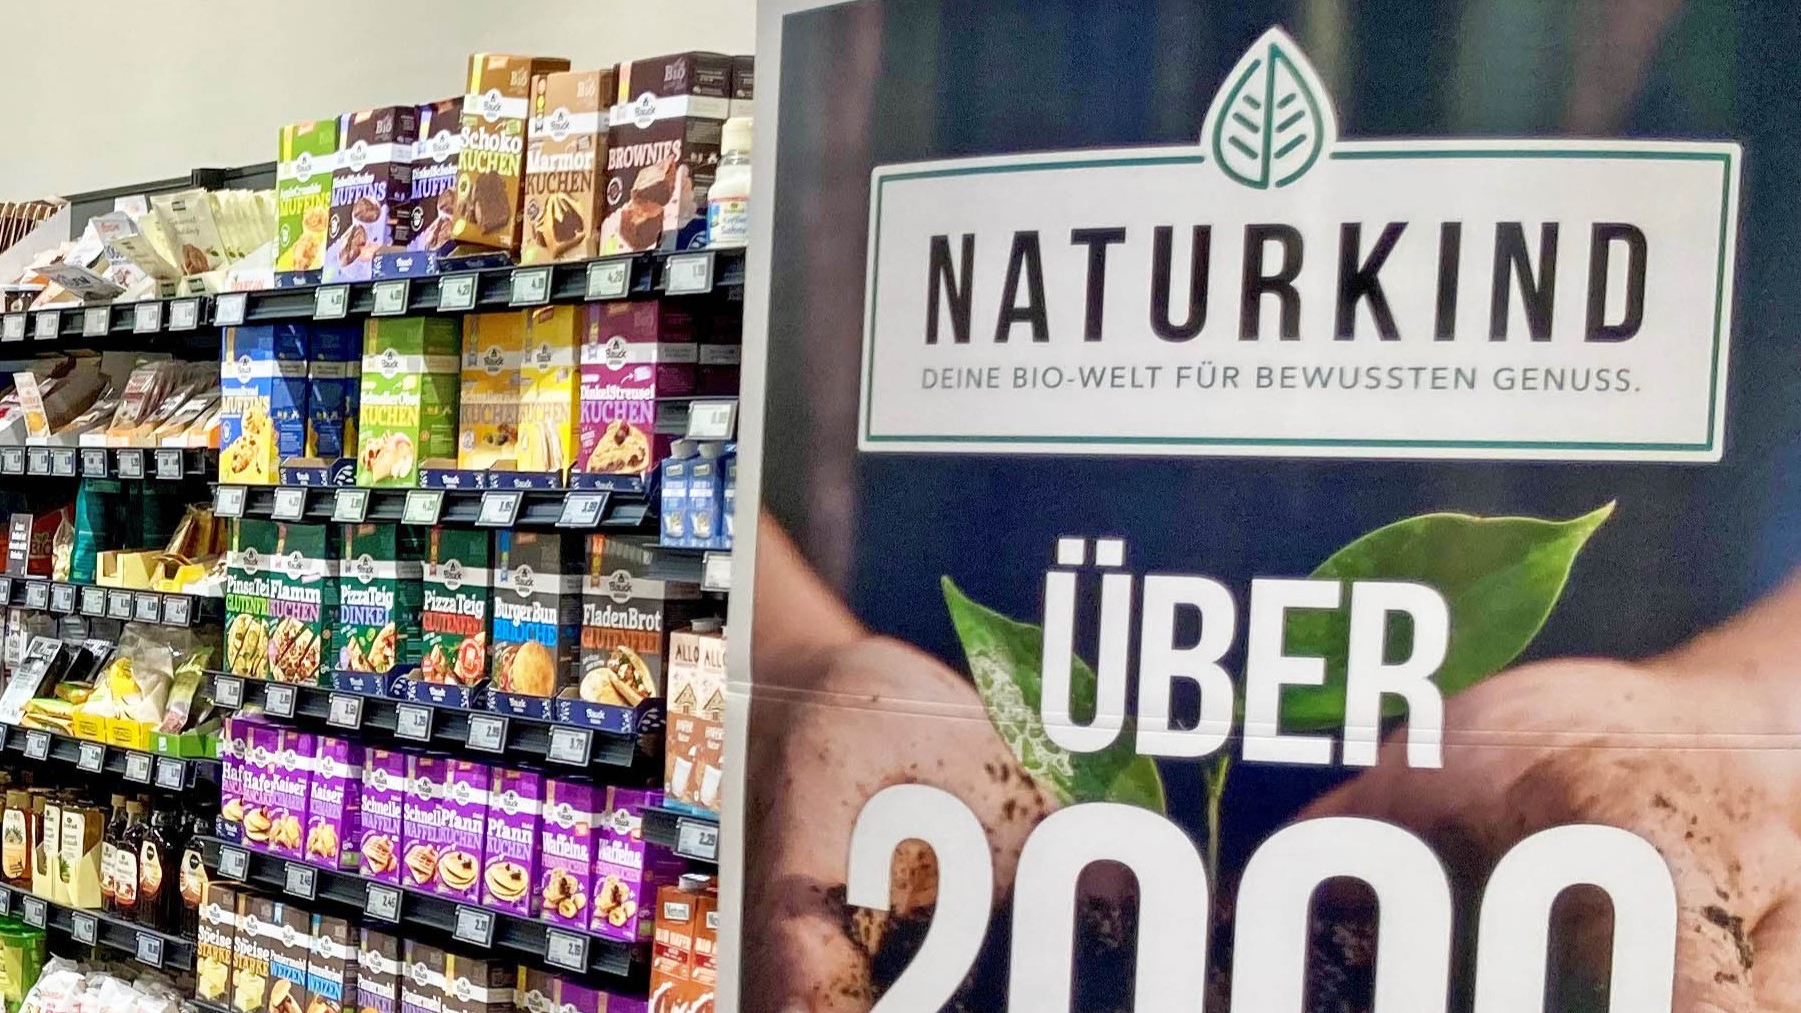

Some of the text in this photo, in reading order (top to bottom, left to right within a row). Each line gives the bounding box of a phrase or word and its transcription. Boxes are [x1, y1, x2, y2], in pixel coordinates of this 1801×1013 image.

[460, 126, 523, 155] Schoko
[458, 149, 522, 177] KUCHEN
[525, 151, 594, 174] Marmor
[607, 139, 682, 171] BROWNIES
[332, 180, 387, 206] MUFFINS
[525, 171, 593, 194] KUCHEN
[924, 221, 1649, 345] NATURKIND
[921, 360, 1641, 394] DEINE BIO-WELT FÜR BEWUSSTEN GENUSS.
[360, 404, 419, 427] KUCHEN
[580, 401, 656, 425] KUCHEN
[227, 575, 270, 599] PinsaTei
[271, 579, 321, 604] Flamm
[340, 585, 394, 610] PizzaTeig
[269, 600, 320, 622] KUCHEN
[340, 605, 390, 626] DINKEL
[423, 591, 485, 619] PizzaTeig
[494, 597, 558, 627] BurgerBun
[583, 603, 662, 632] FladenBrot
[494, 623, 558, 647] BRIOCHE
[1041, 537, 1452, 770] ÜBER
[222, 761, 244, 782] Haf
[311, 780, 343, 804] Kaiser
[441, 807, 483, 832] Pfann
[488, 818, 534, 843] Pfann
[486, 838, 533, 862] KUCHEN
[198, 925, 232, 950] Speise
[233, 936, 270, 961] Speise
[270, 961, 306, 987] WEIZEN
[308, 973, 343, 1001] WEIZEN
